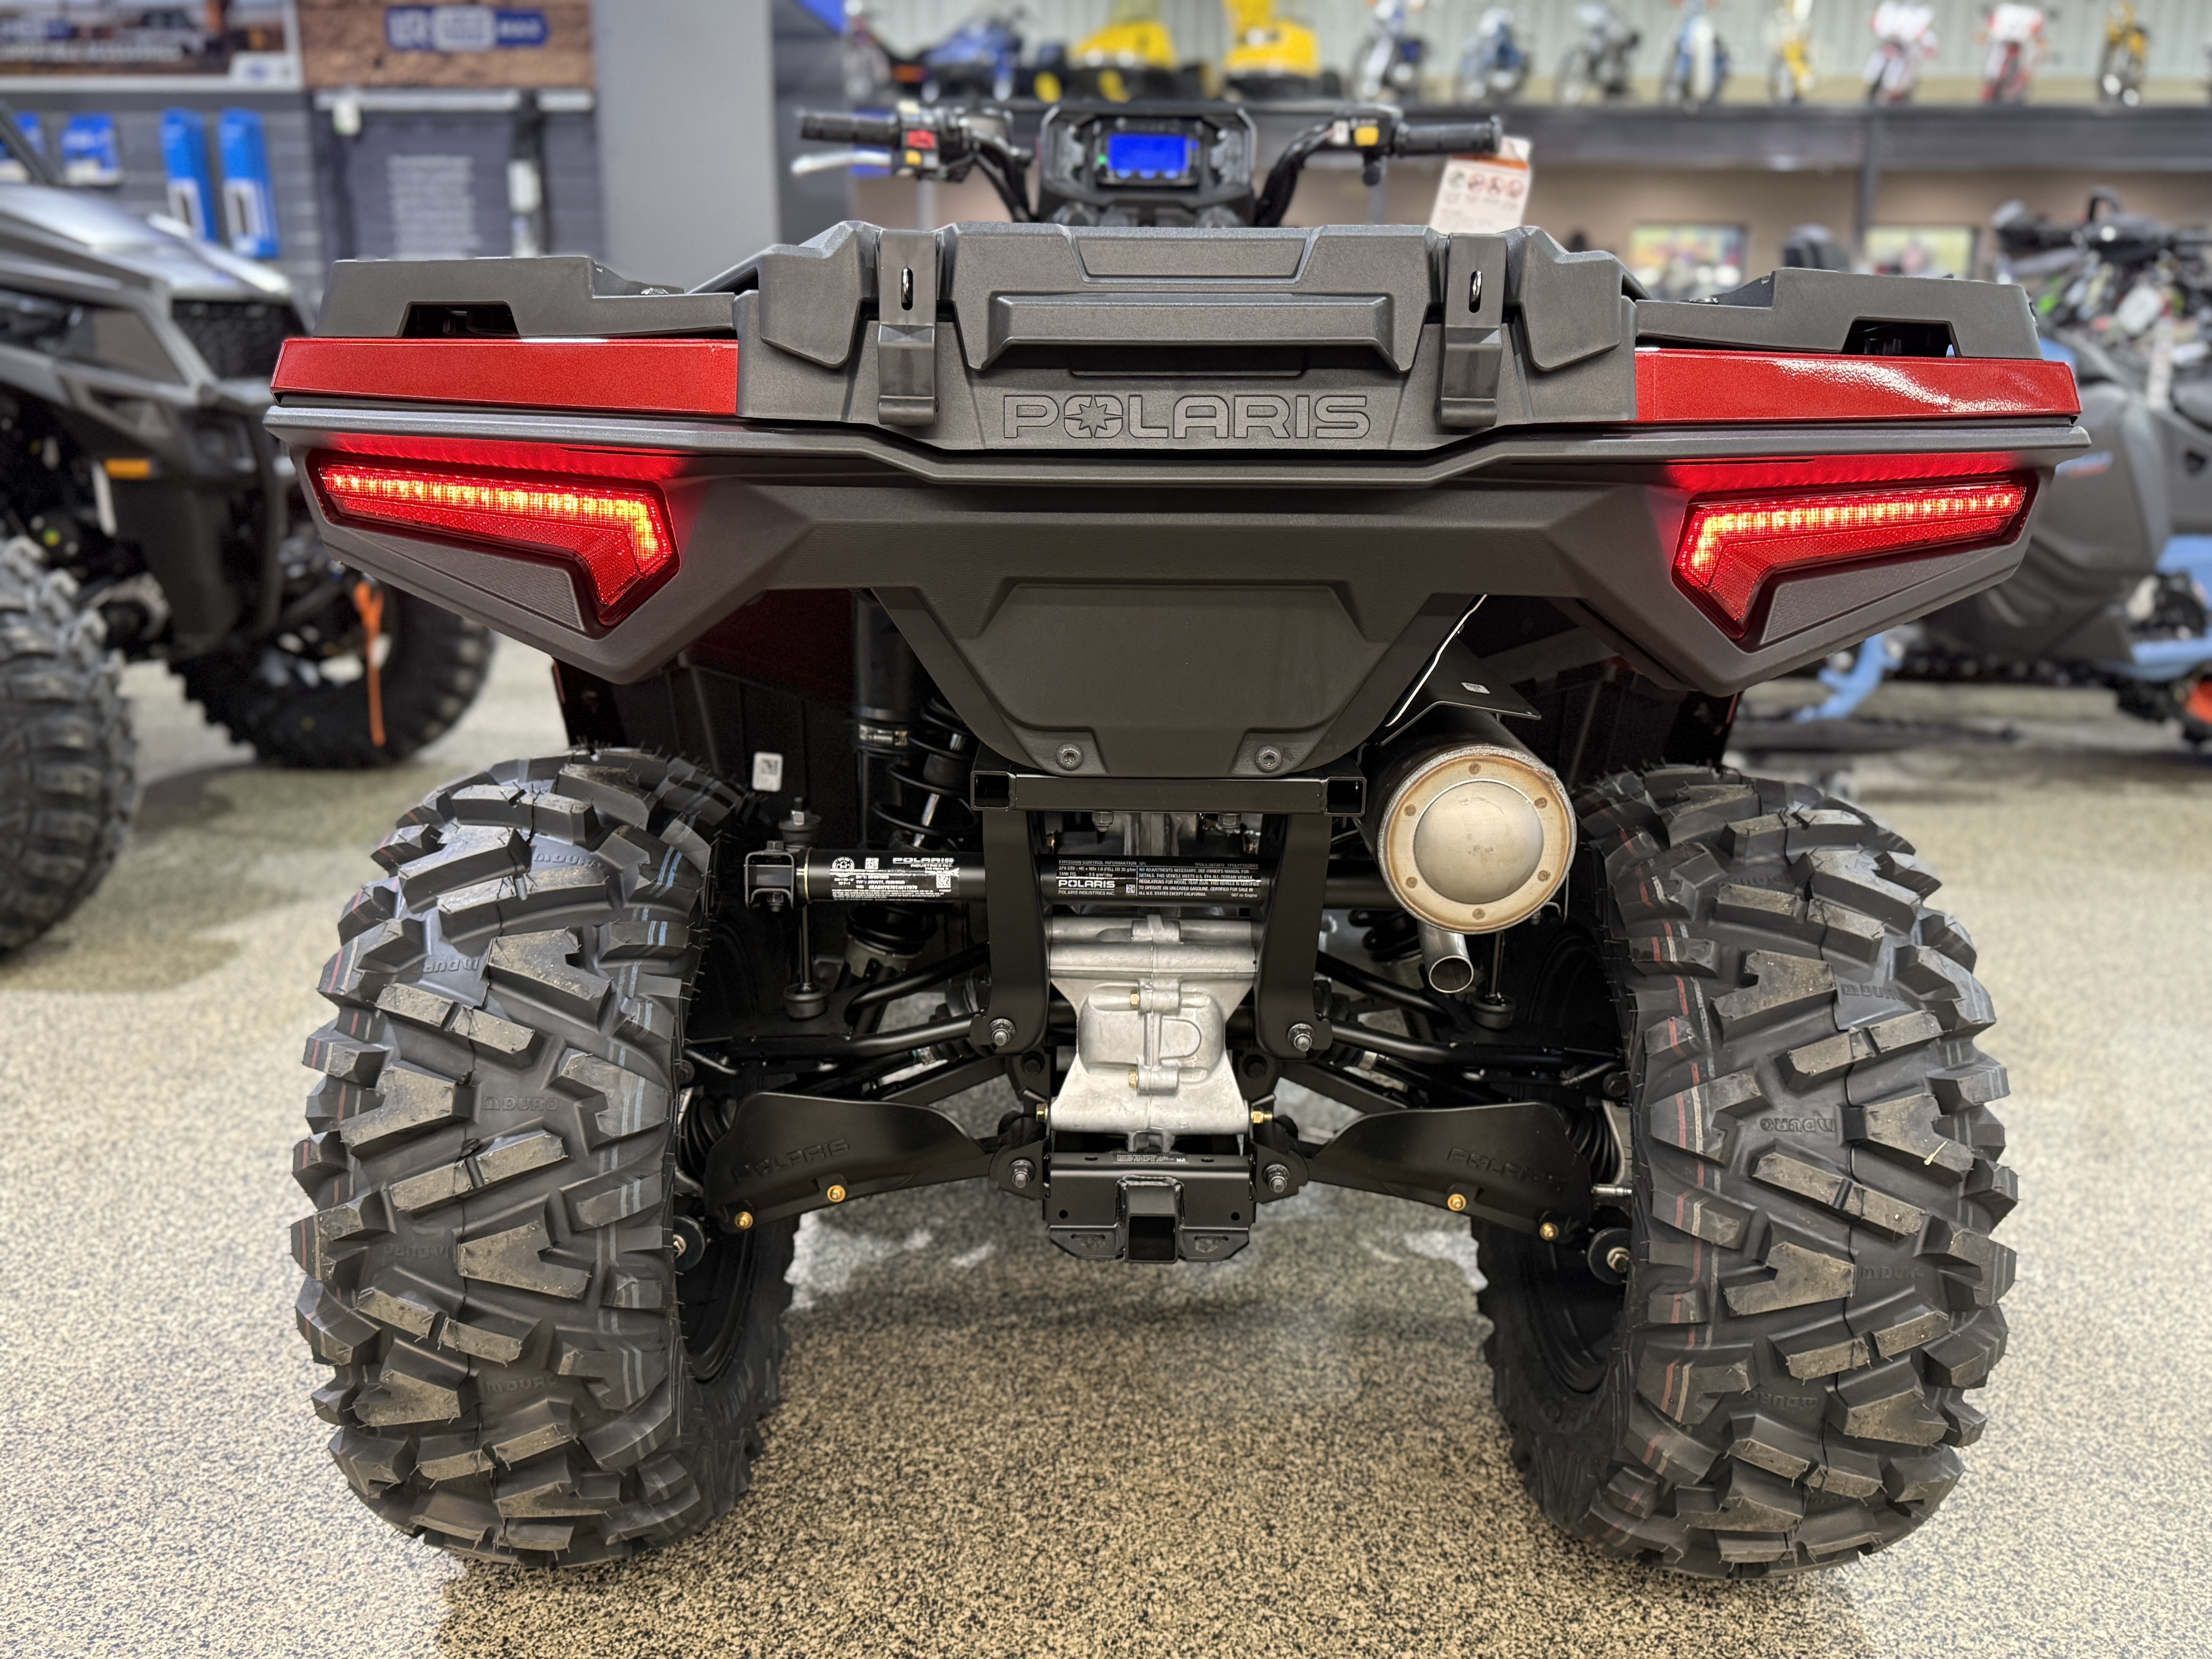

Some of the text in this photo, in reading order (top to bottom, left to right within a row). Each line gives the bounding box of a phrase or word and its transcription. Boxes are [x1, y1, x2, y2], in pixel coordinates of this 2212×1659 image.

[1003, 395, 1370, 438] POLARIS
[1058, 879, 1115, 888] POLARIS
[502, 1096, 560, 1110] DURO
[1760, 1117, 1816, 1132] DURO
